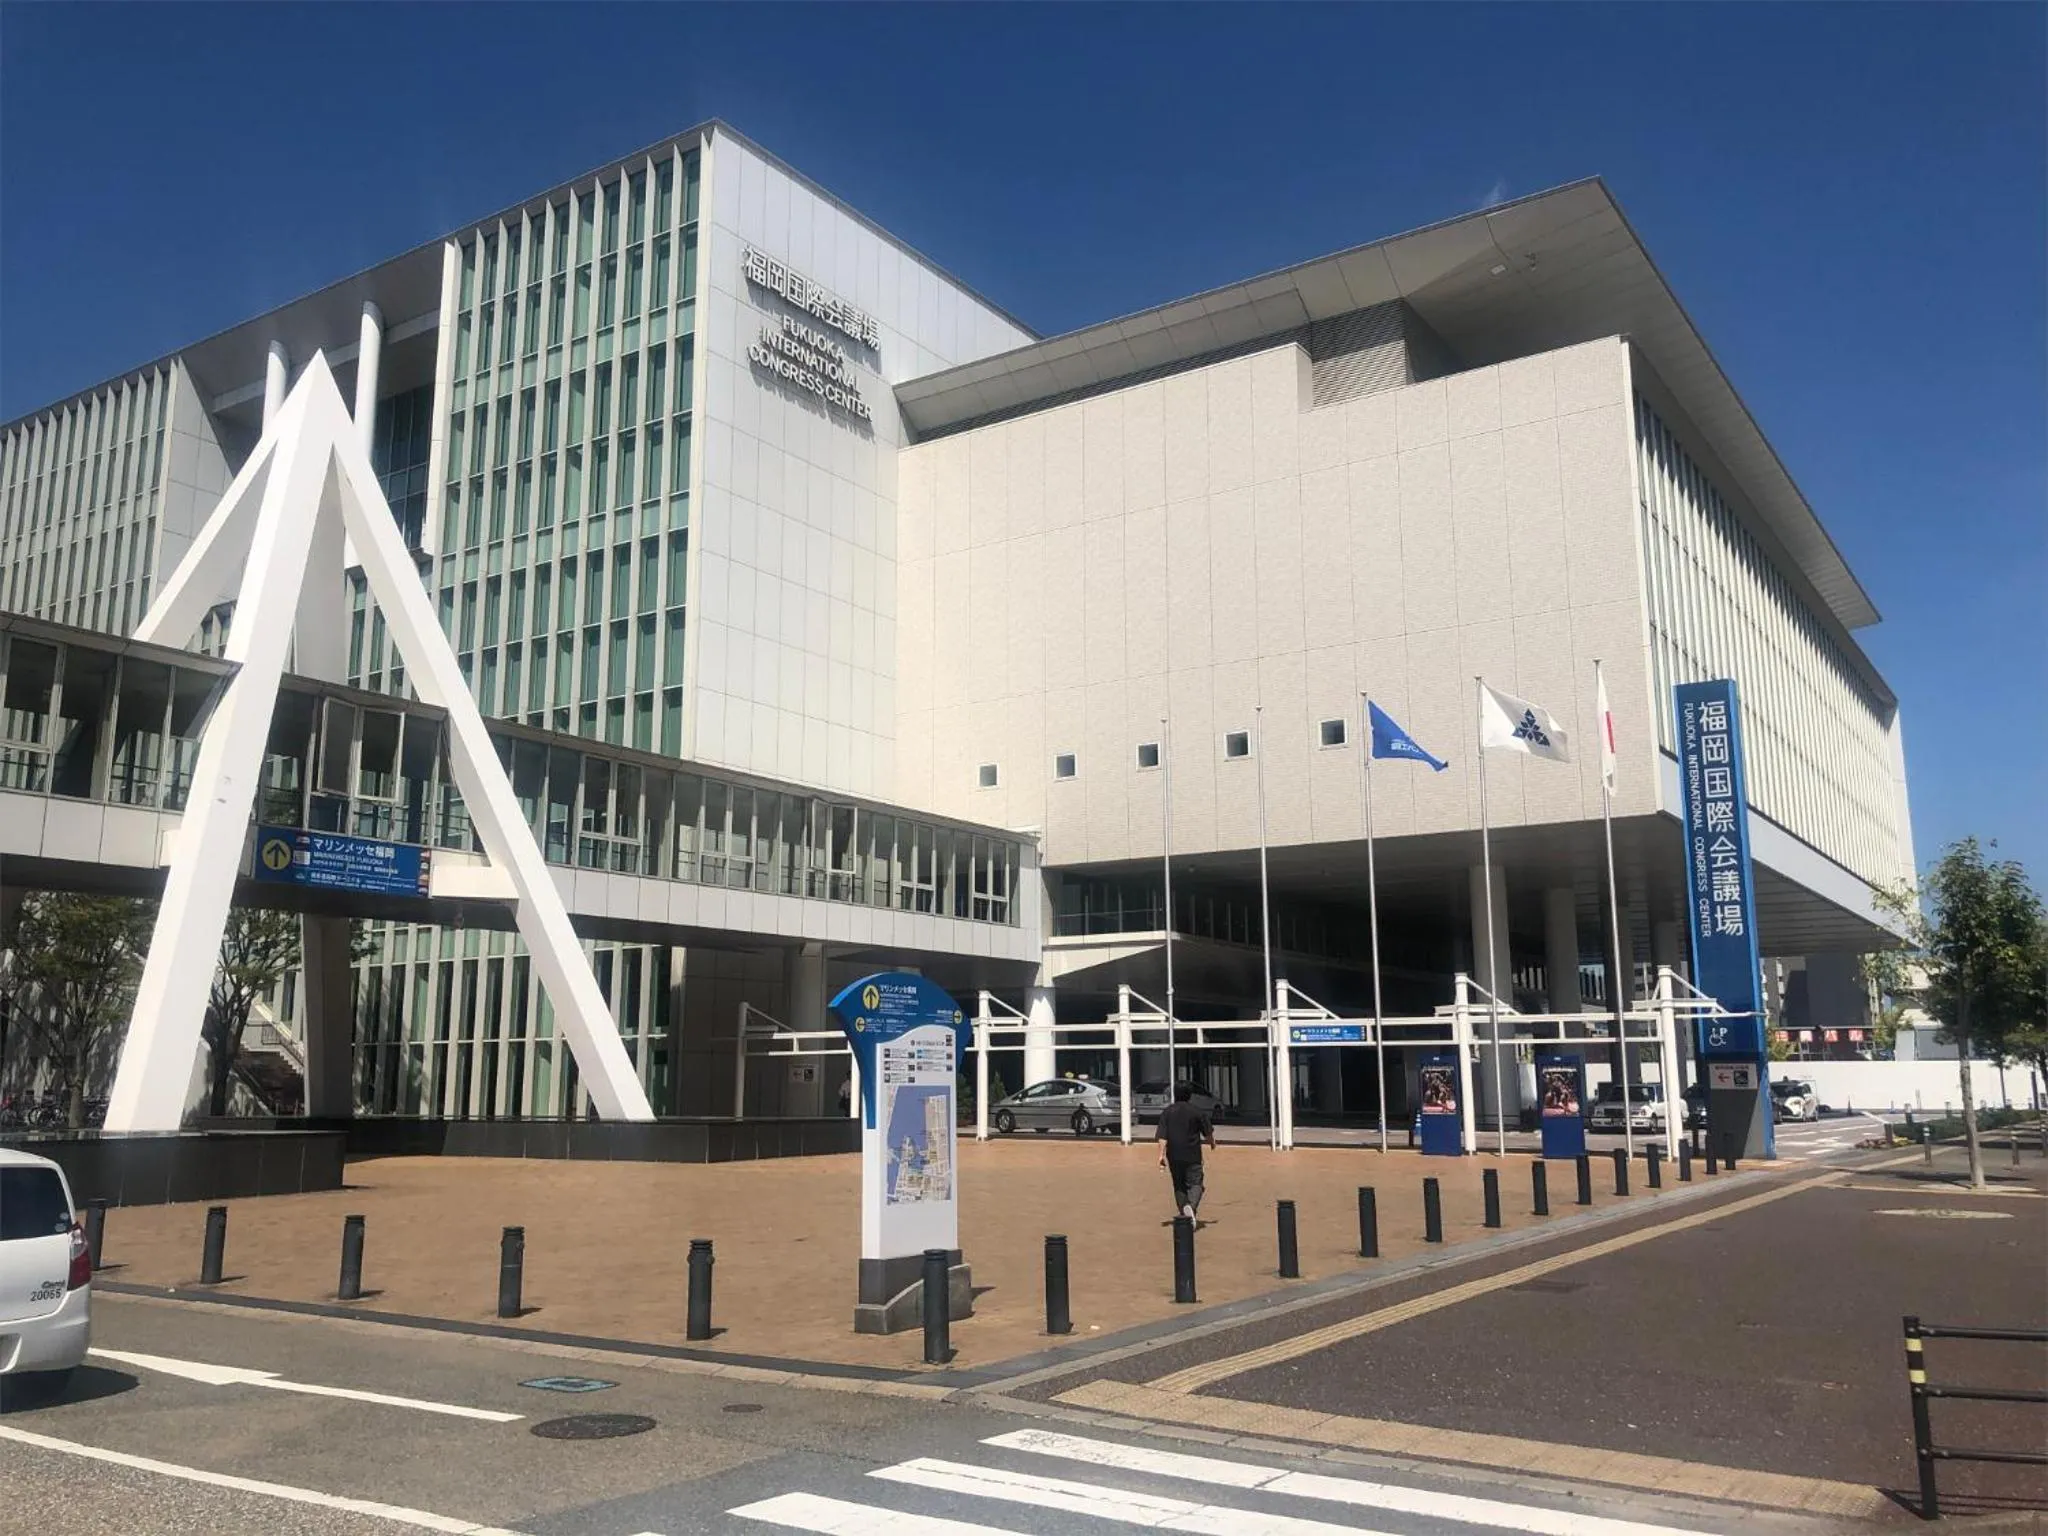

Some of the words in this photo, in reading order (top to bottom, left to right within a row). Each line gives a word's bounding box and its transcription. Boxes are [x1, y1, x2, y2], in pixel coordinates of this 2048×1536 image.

[743, 246, 881, 351] 福岡国際会議場
[762, 326, 861, 391] INTERNATIONAL
[783, 316, 846, 363] FUKUOKA
[749, 344, 824, 396] CONGRESS
[825, 382, 872, 421] CENTER
[1683, 702, 1695, 750] FUKUOKA
[1687, 754, 1703, 829] INTERNATIONAL
[1698, 700, 1744, 936] 福岡国際会議場
[313, 839, 395, 859] マリンメッセ福岡
[1694, 836, 1708, 893] CONGRESS
[1699, 898, 1712, 938] CENTER
